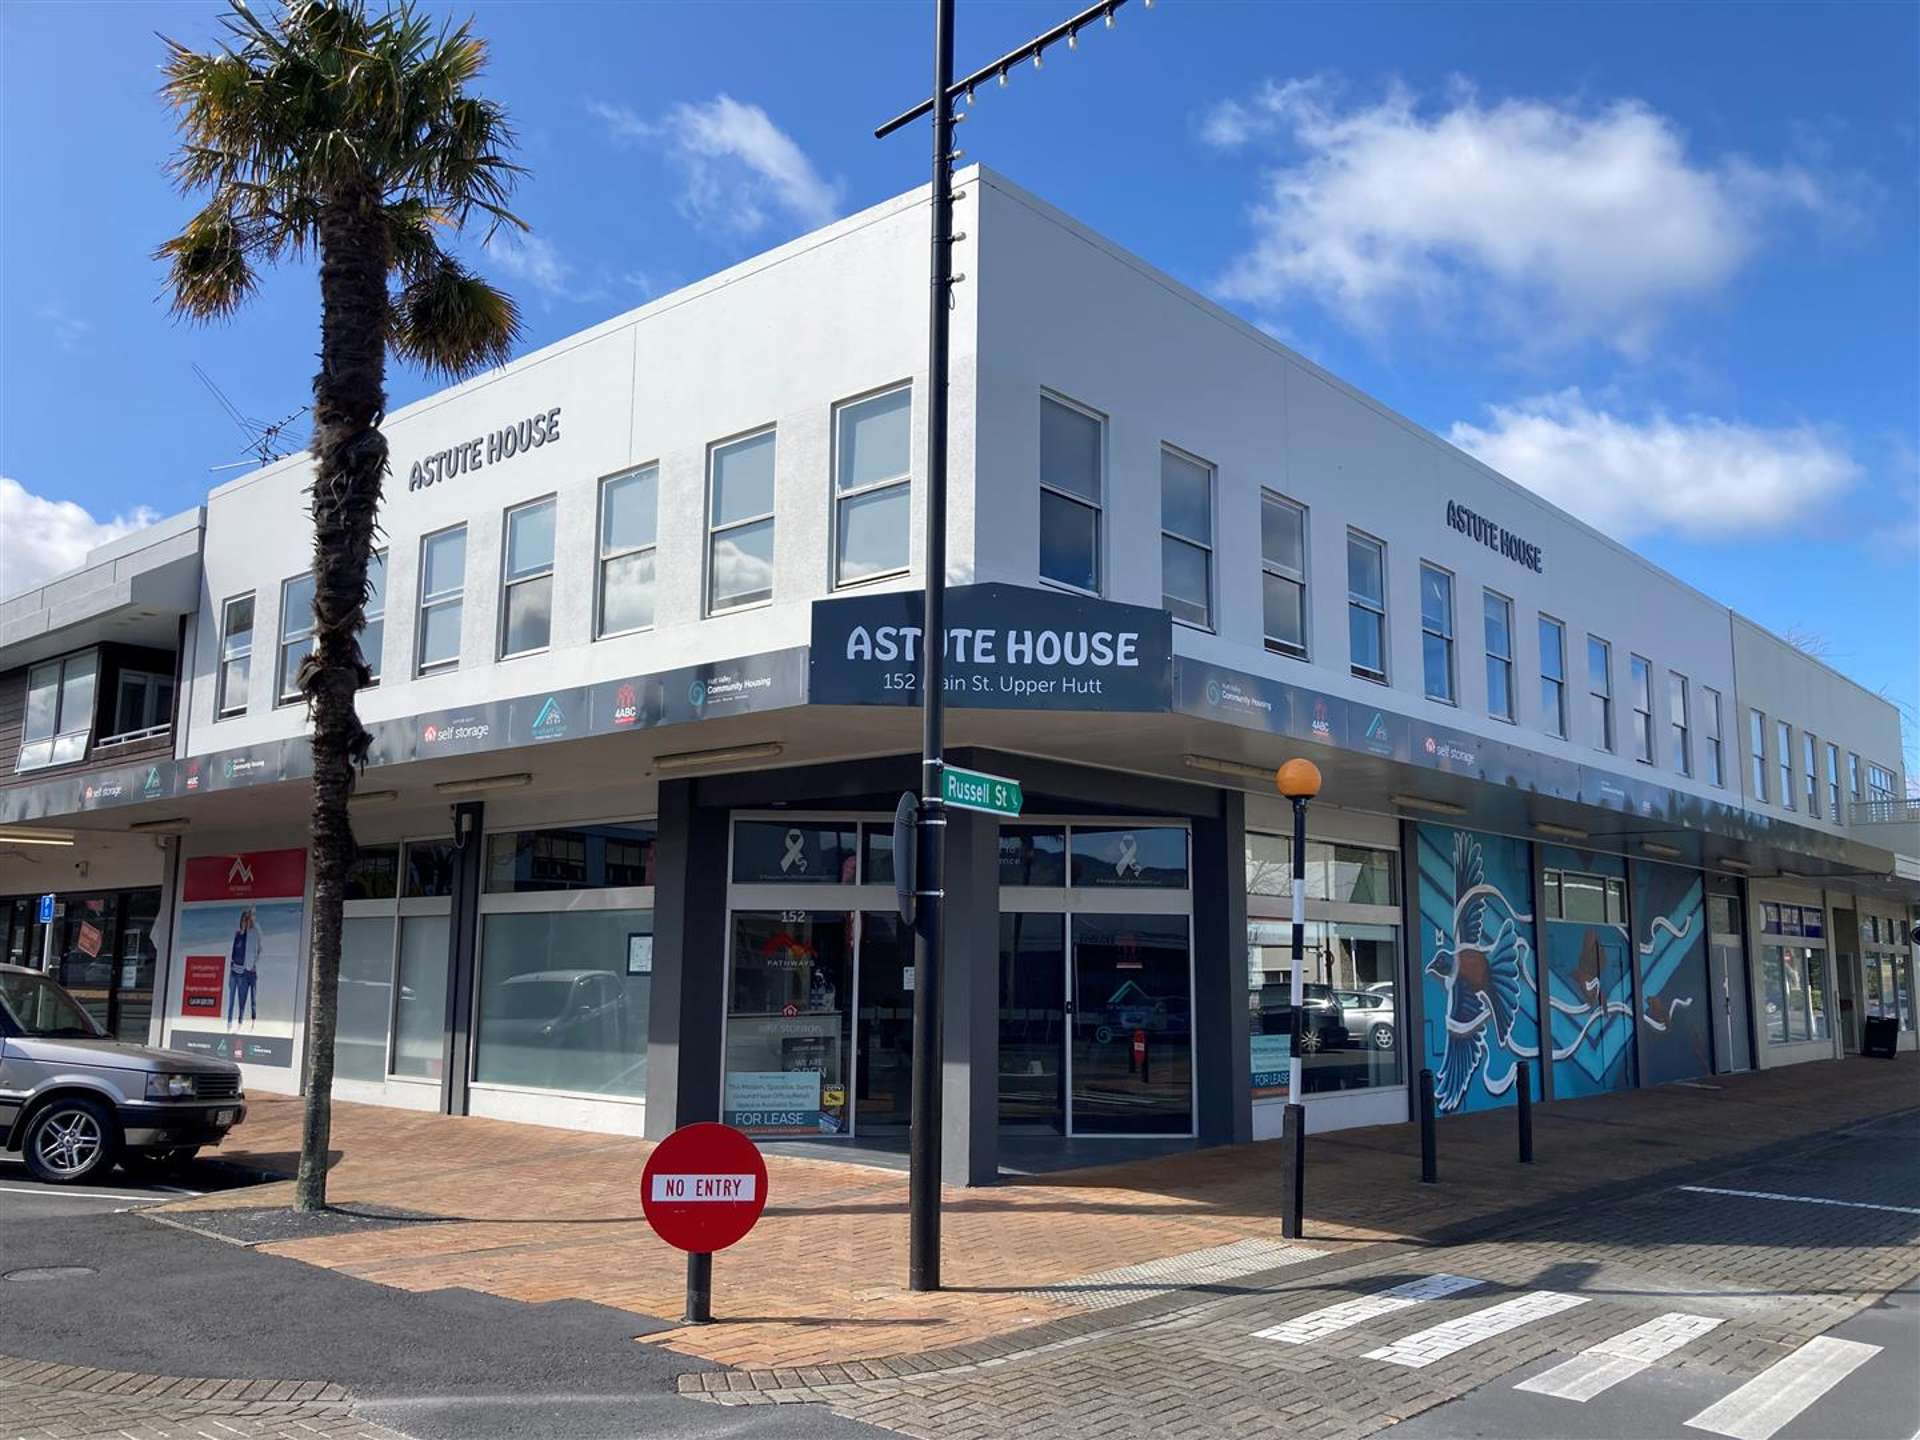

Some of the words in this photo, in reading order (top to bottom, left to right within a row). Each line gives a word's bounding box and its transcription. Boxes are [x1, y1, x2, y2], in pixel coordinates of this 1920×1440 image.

[409, 437, 484, 492] ASTUTE
[486, 407, 561, 465] HOUSE
[1446, 499, 1498, 552] ASTUTE
[1500, 528, 1542, 574] HOUSE
[846, 625, 996, 663] ASTTE
[1007, 630, 1139, 666] HOUSE
[707, 683, 742, 695] Community
[744, 677, 771, 688] Housing
[884, 673, 916, 690] 152
[923, 675, 966, 691] ain
[972, 676, 994, 692] St.
[1000, 676, 1056, 696] Upper
[1062, 677, 1102, 694] Hutt
[437, 725, 453, 741] self
[455, 723, 489, 740] storage
[948, 775, 989, 804] Russell
[995, 784, 1007, 807] St
[782, 911, 806, 923] 152
[767, 960, 815, 968] PATHWAYS
[735, 1112, 763, 1125] FOR
[764, 1112, 804, 1125] LEASE
[665, 1179, 685, 1197] NO
[695, 1179, 742, 1197] ENTRY
